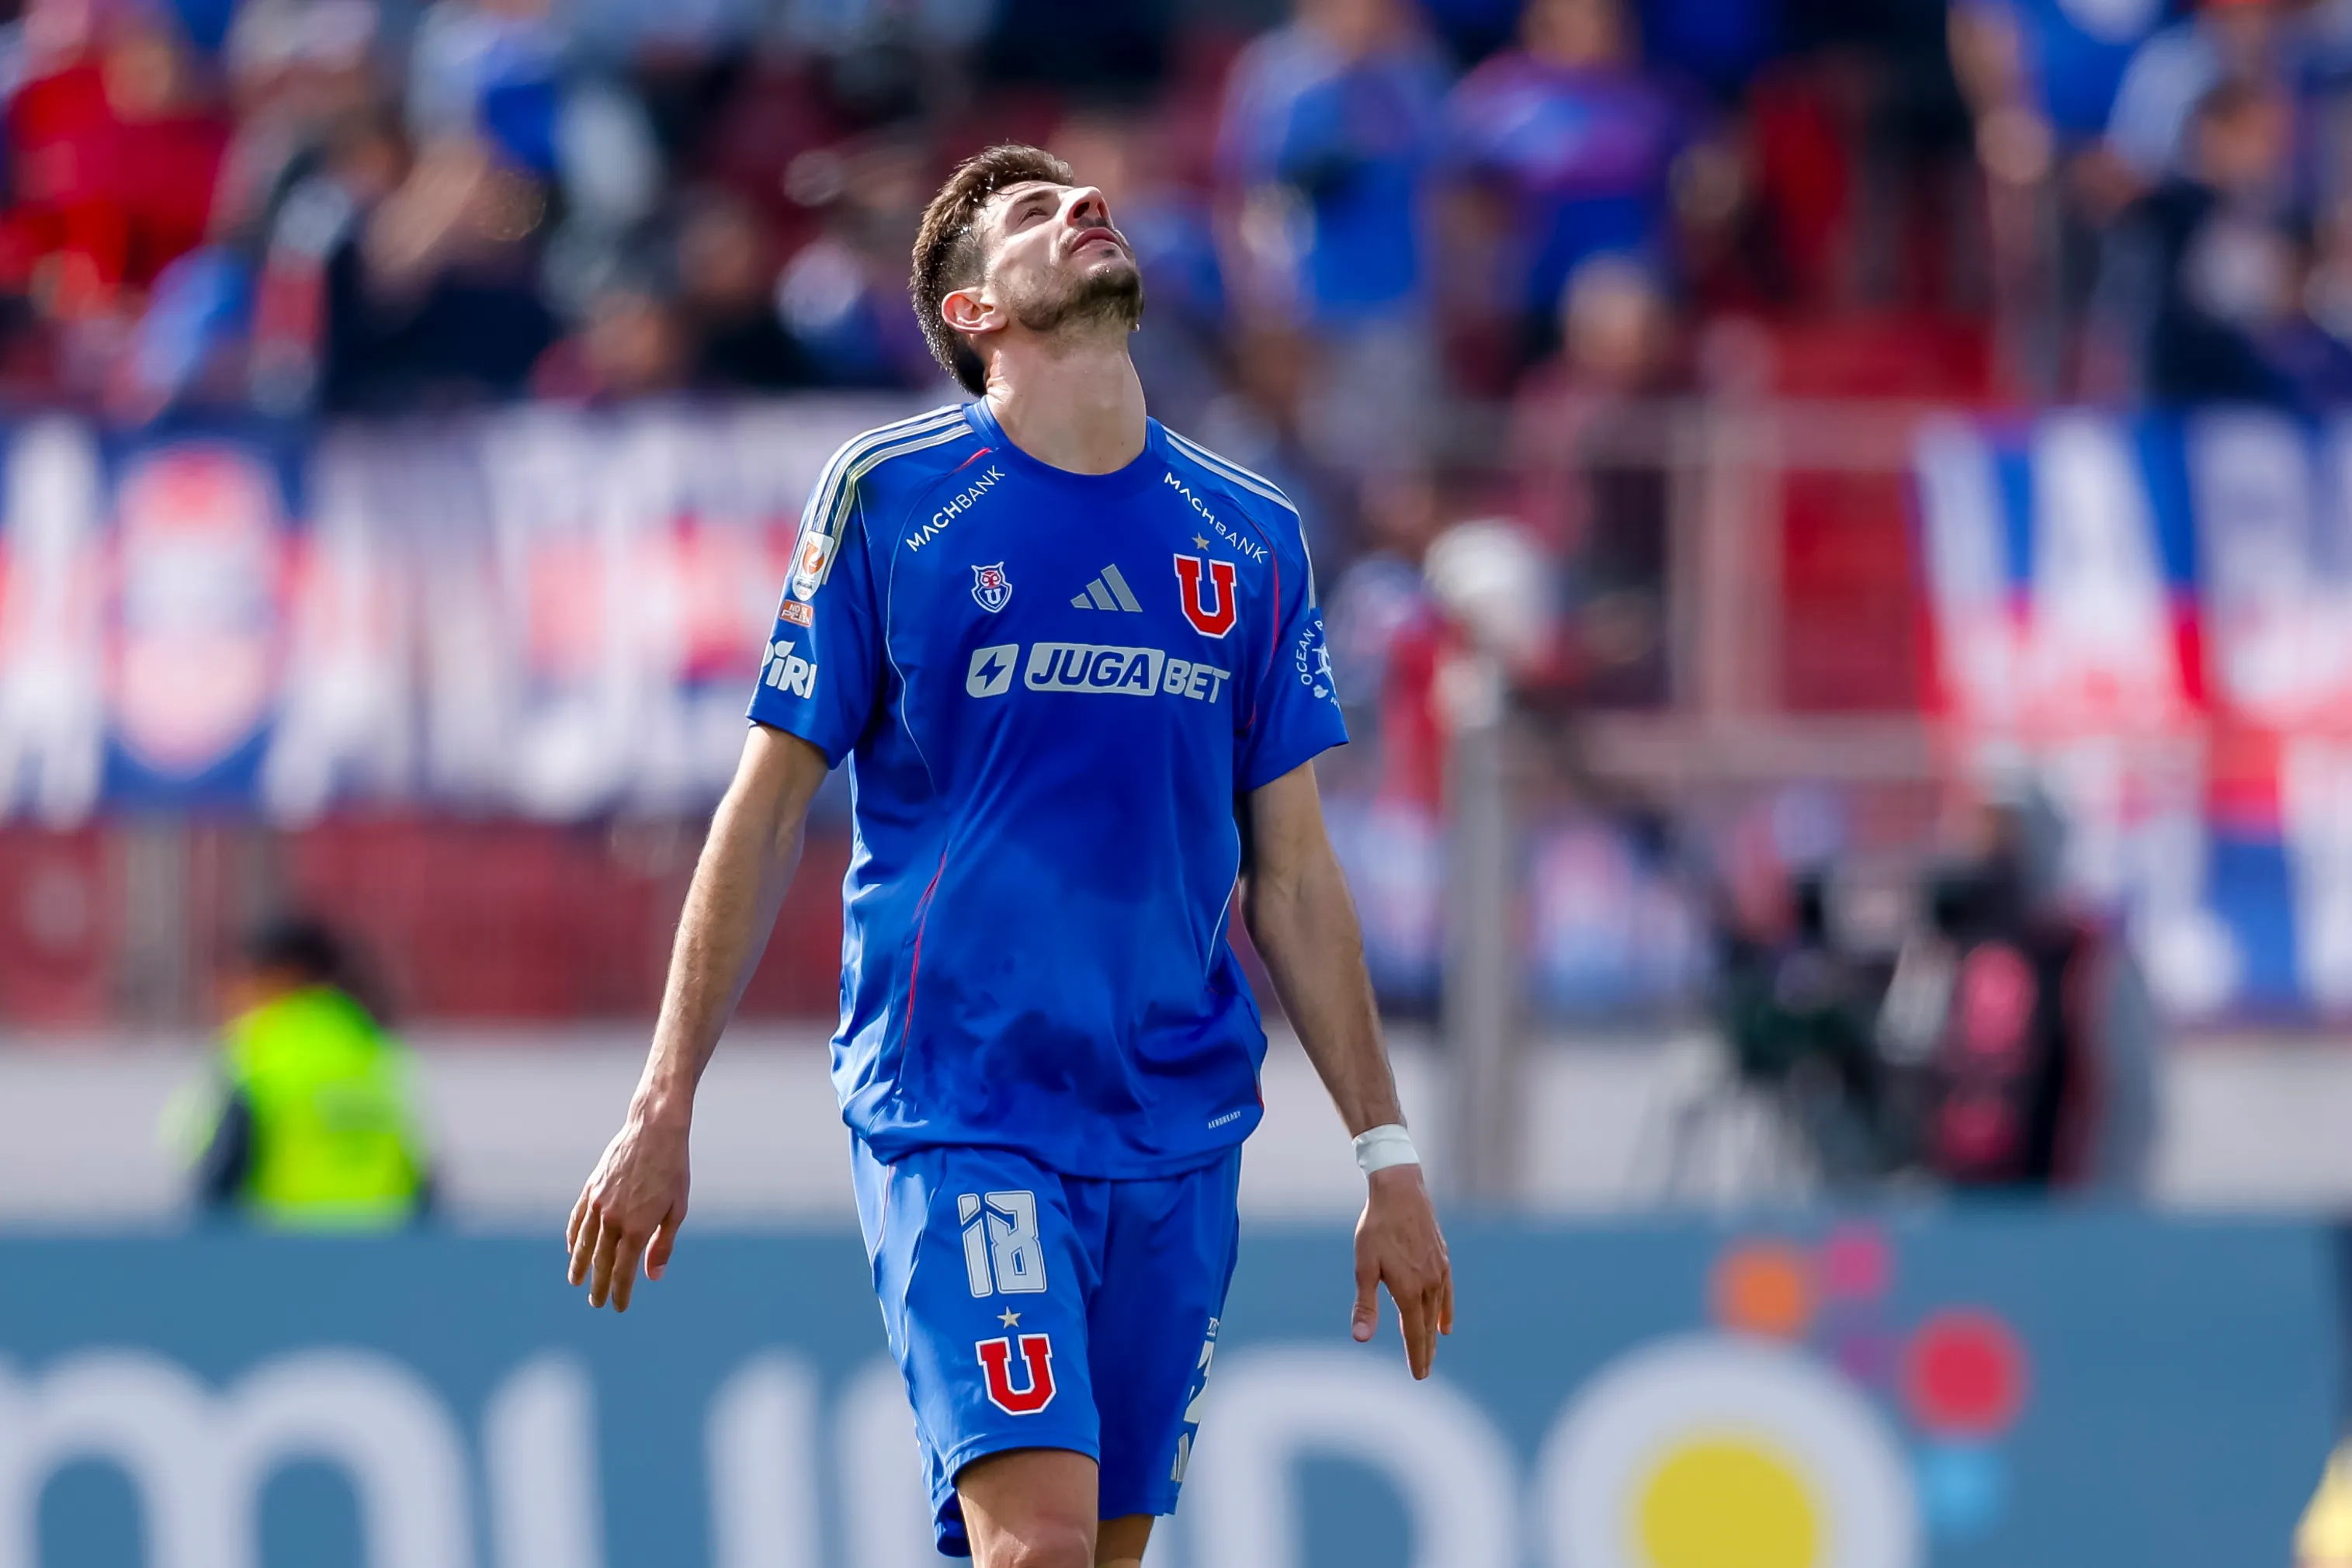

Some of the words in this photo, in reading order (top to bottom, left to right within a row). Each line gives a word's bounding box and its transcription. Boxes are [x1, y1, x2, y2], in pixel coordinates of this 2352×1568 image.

[906, 465, 1005, 552] MACHBANK
[1164, 472, 1268, 564] MACHBANK
[1173, 553, 1237, 639] U
[1296, 628, 1316, 685] OCEAN
[957, 1190, 1047, 1298] 18
[975, 1333, 1056, 1416] U
